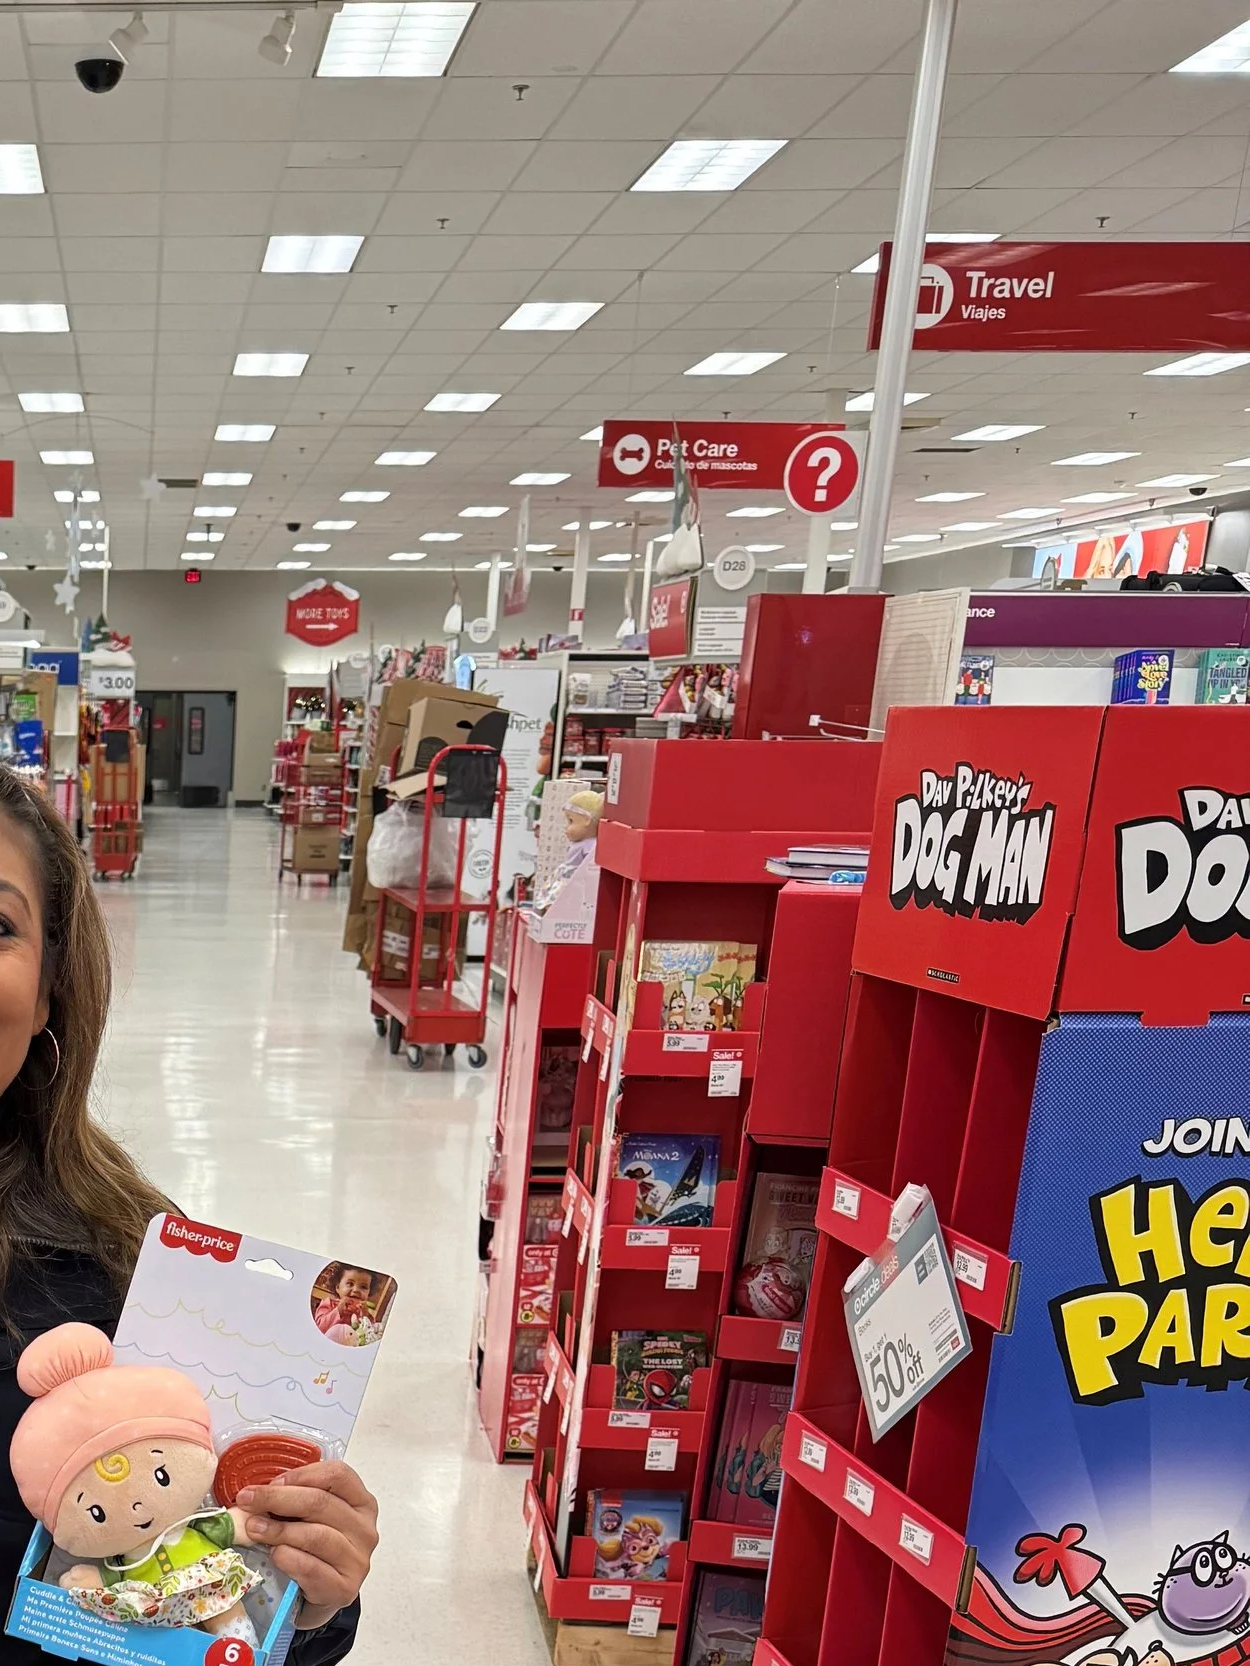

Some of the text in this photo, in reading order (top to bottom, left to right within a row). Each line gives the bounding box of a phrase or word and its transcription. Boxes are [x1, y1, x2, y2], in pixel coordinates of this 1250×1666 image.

[965, 270, 1055, 299] Travel
[961, 305, 1007, 322] Viajes
[693, 439, 739, 457] Care
[696, 460, 758, 472] de mascotas
[722, 560, 747, 572] D28
[296, 607, 350, 619] MORE TOYS
[965, 606, 996, 618] ance
[1209, 667, 1248, 679] TANGLED
[922, 770, 953, 808] DAV
[891, 798, 1054, 906] DOG MAN
[1121, 820, 1250, 935] DO
[712, 1050, 735, 1061] Sale!
[632, 1150, 680, 1162] MOANA 2
[165, 1221, 235, 1252] fisher-price
[1100, 1183, 1250, 1287] He
[670, 1246, 693, 1256] Sale!
[859, 1274, 881, 1308] circle
[642, 1357, 683, 1366] THE LOST
[906, 1352, 925, 1386] off
[650, 1428, 673, 1439] Sale!
[28, 1585, 64, 1602] Cuddle &
[634, 1595, 655, 1606] Sale!
[25, 1595, 103, 1626] Ma Première Poupée
[22, 1605, 126, 1644] Meine erste Schmusepuppe
[17, 1624, 50, 1640] Primeira
[50, 1634, 79, 1649] Boneca
[79, 1643, 100, 1655] Sons
[20, 1615, 30, 1623] Mi
[31, 1618, 61, 1634] primera
[92, 1637, 129, 1654] Abracitos
[136, 1651, 167, 1666] ruiditos
[224, 1642, 242, 1664] 6
